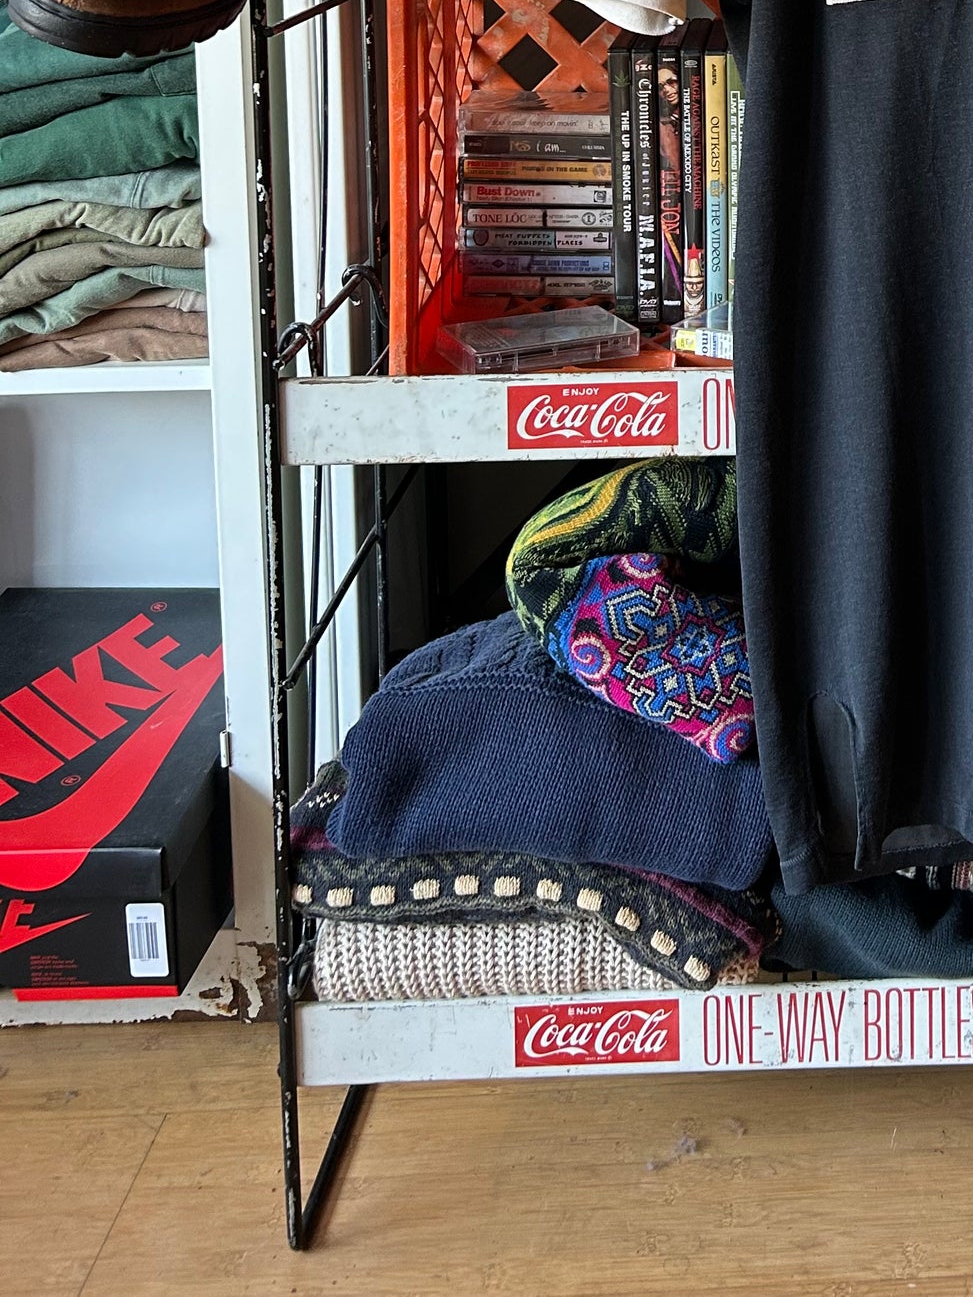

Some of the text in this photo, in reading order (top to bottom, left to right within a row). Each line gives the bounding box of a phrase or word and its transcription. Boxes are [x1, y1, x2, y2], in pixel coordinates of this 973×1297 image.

[637, 78, 653, 149] Chronicles
[683, 104, 691, 132] BATTLE
[684, 133, 692, 143] OF
[691, 75, 703, 210] RAGE AGAINST THE MACHINE
[620, 111, 633, 233] THE UP IN SMOKE TOUR
[684, 144, 692, 173] MEXICO
[477, 186, 535, 198] Bust Down
[660, 170, 681, 235] LIL JON
[684, 174, 692, 193] CITY
[473, 214, 502, 223] TONE
[638, 215, 656, 296] M.A.F.I.A.
[562, 387, 599, 396] ENJOY
[517, 391, 671, 439] Coca-Cola
[567, 1005, 603, 1015] ENJOY
[703, 991, 845, 1066] ONE-WAY
[523, 1008, 673, 1058] Coca-Cola
